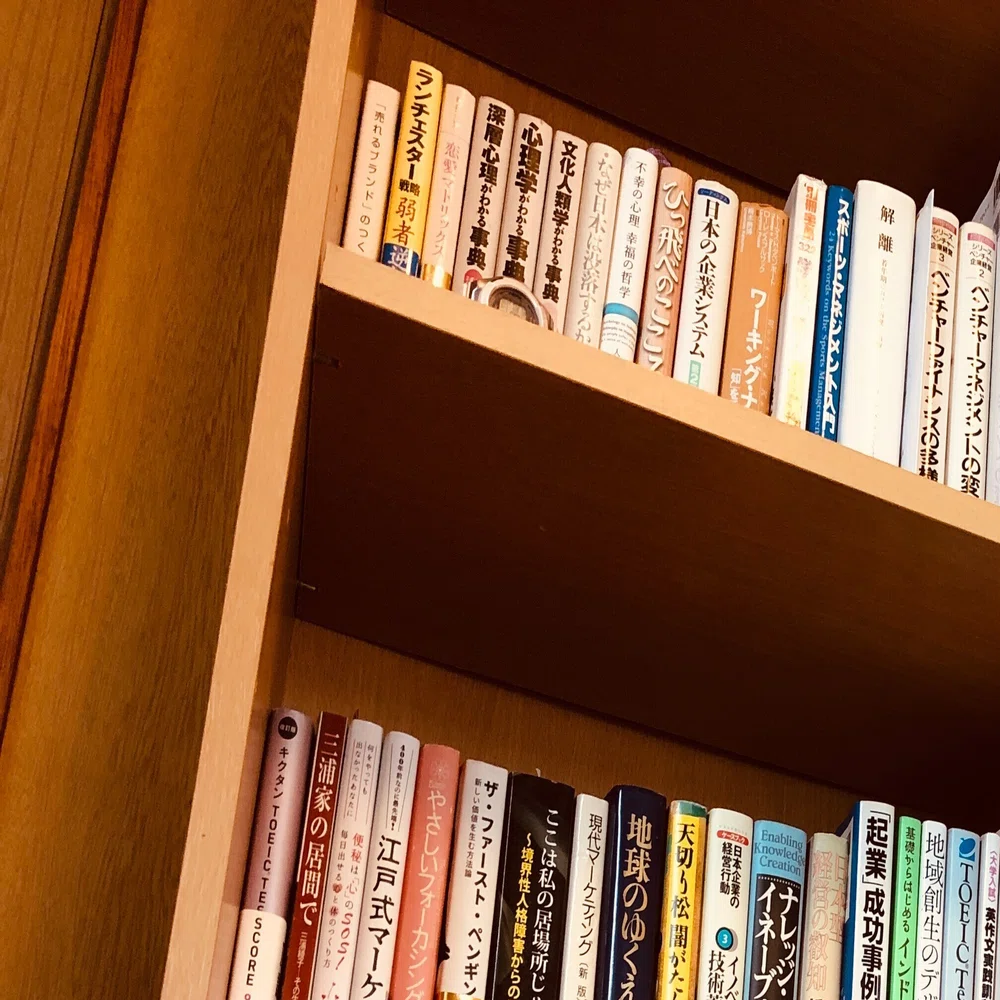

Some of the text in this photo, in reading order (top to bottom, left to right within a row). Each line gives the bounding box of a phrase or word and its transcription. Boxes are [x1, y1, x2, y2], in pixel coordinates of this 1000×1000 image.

[392, 68, 437, 246] ランチェスター戦略 弱者
[466, 103, 507, 271] 深層心理がわかる事典
[502, 122, 543, 283] 心理学がわかる事典
[542, 140, 578, 304] 文化人類学がわかる事典
[627, 161, 648, 229] 不幸の心理
[878, 205, 895, 254] 解離
[618, 233, 638, 299] 幸福の哲学
[690, 199, 720, 358] 日本の企業システム
[970, 251, 994, 266] ベンチャー
[972, 243, 993, 256] シリーズ
[346, 741, 363, 817] 出なかったあなたに
[363, 743, 375, 796] 何をやっても
[263, 747, 289, 874] キクタン TOEIC
[300, 732, 340, 926] 三浦家の居間で
[761, 829, 803, 853] Enabling
[464, 780, 500, 996] ザ・ファースト・ペンギン
[719, 842, 732, 895] 経営行動
[730, 845, 743, 909] 日本企業の
[754, 842, 806, 866] Knowledge
[759, 856, 801, 876] Creation
[902, 826, 916, 933] 基礎からはじめる
[361, 835, 402, 999] 江戸式マーケ
[956, 862, 973, 965] TOEIC
[246, 918, 262, 986] SCORE
